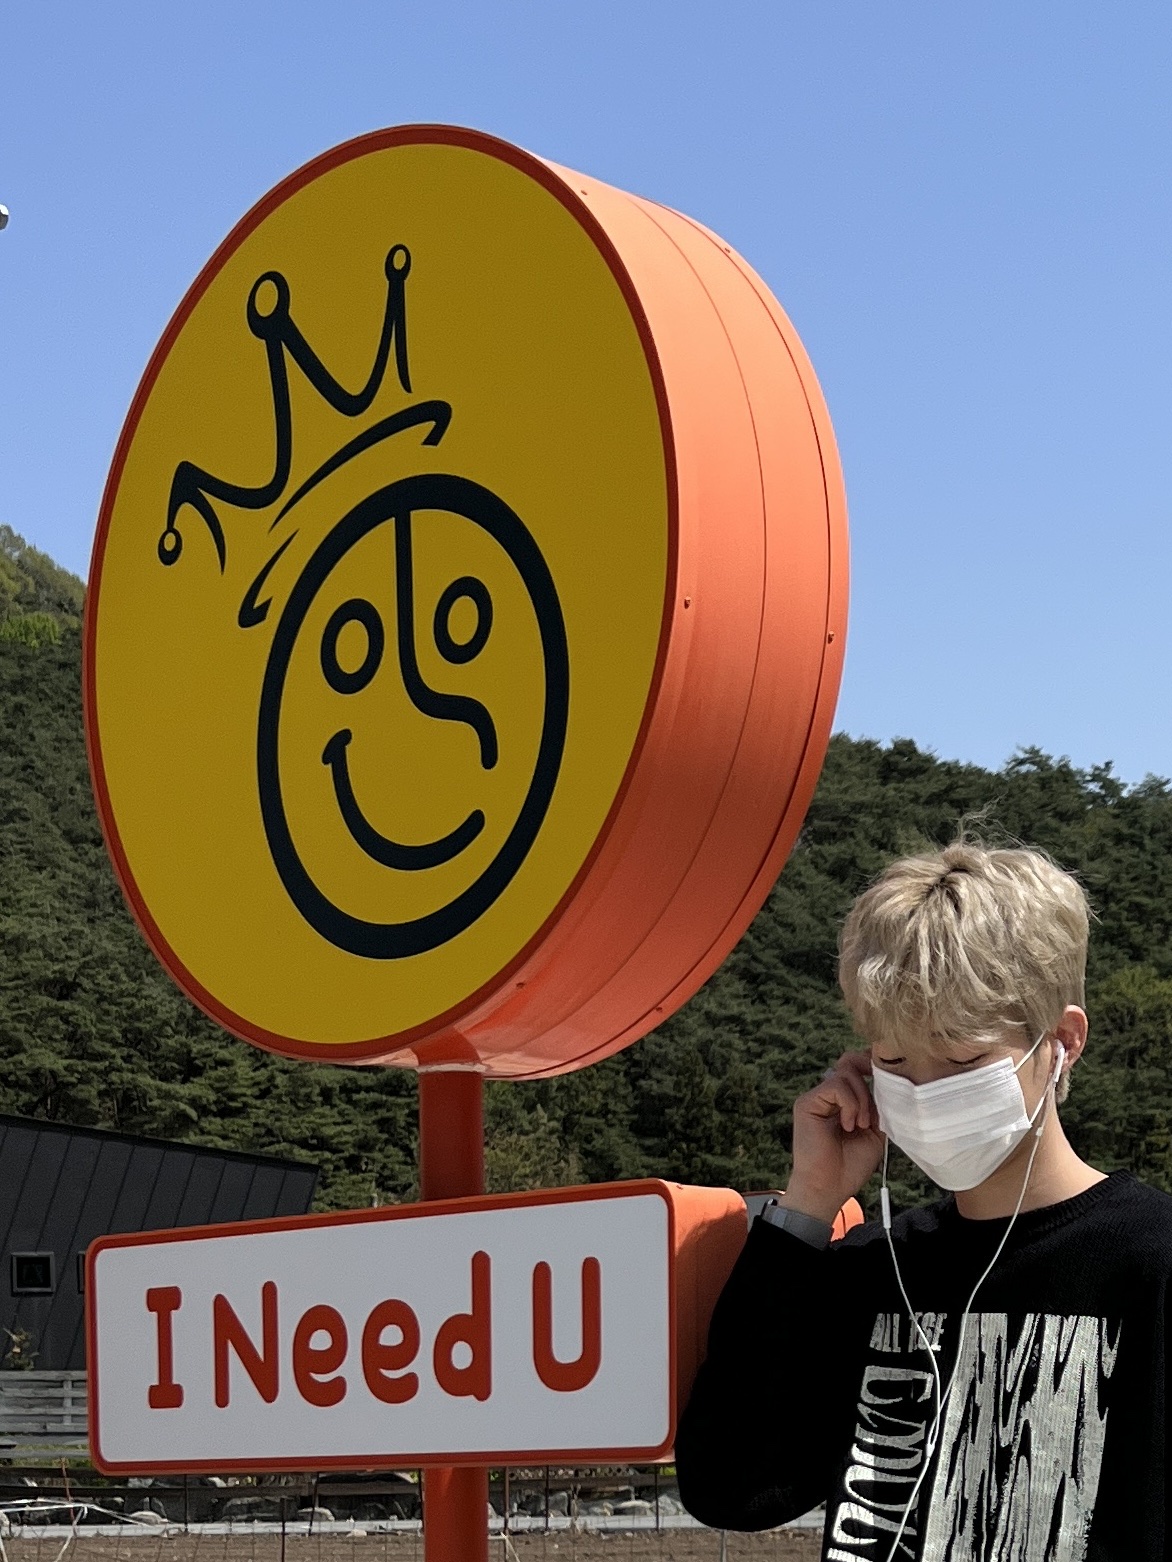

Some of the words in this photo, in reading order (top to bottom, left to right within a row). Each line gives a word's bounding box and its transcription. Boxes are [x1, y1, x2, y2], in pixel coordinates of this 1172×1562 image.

[146, 1286, 184, 1409] I
[212, 1250, 492, 1408] Need
[532, 1256, 601, 1392] U
